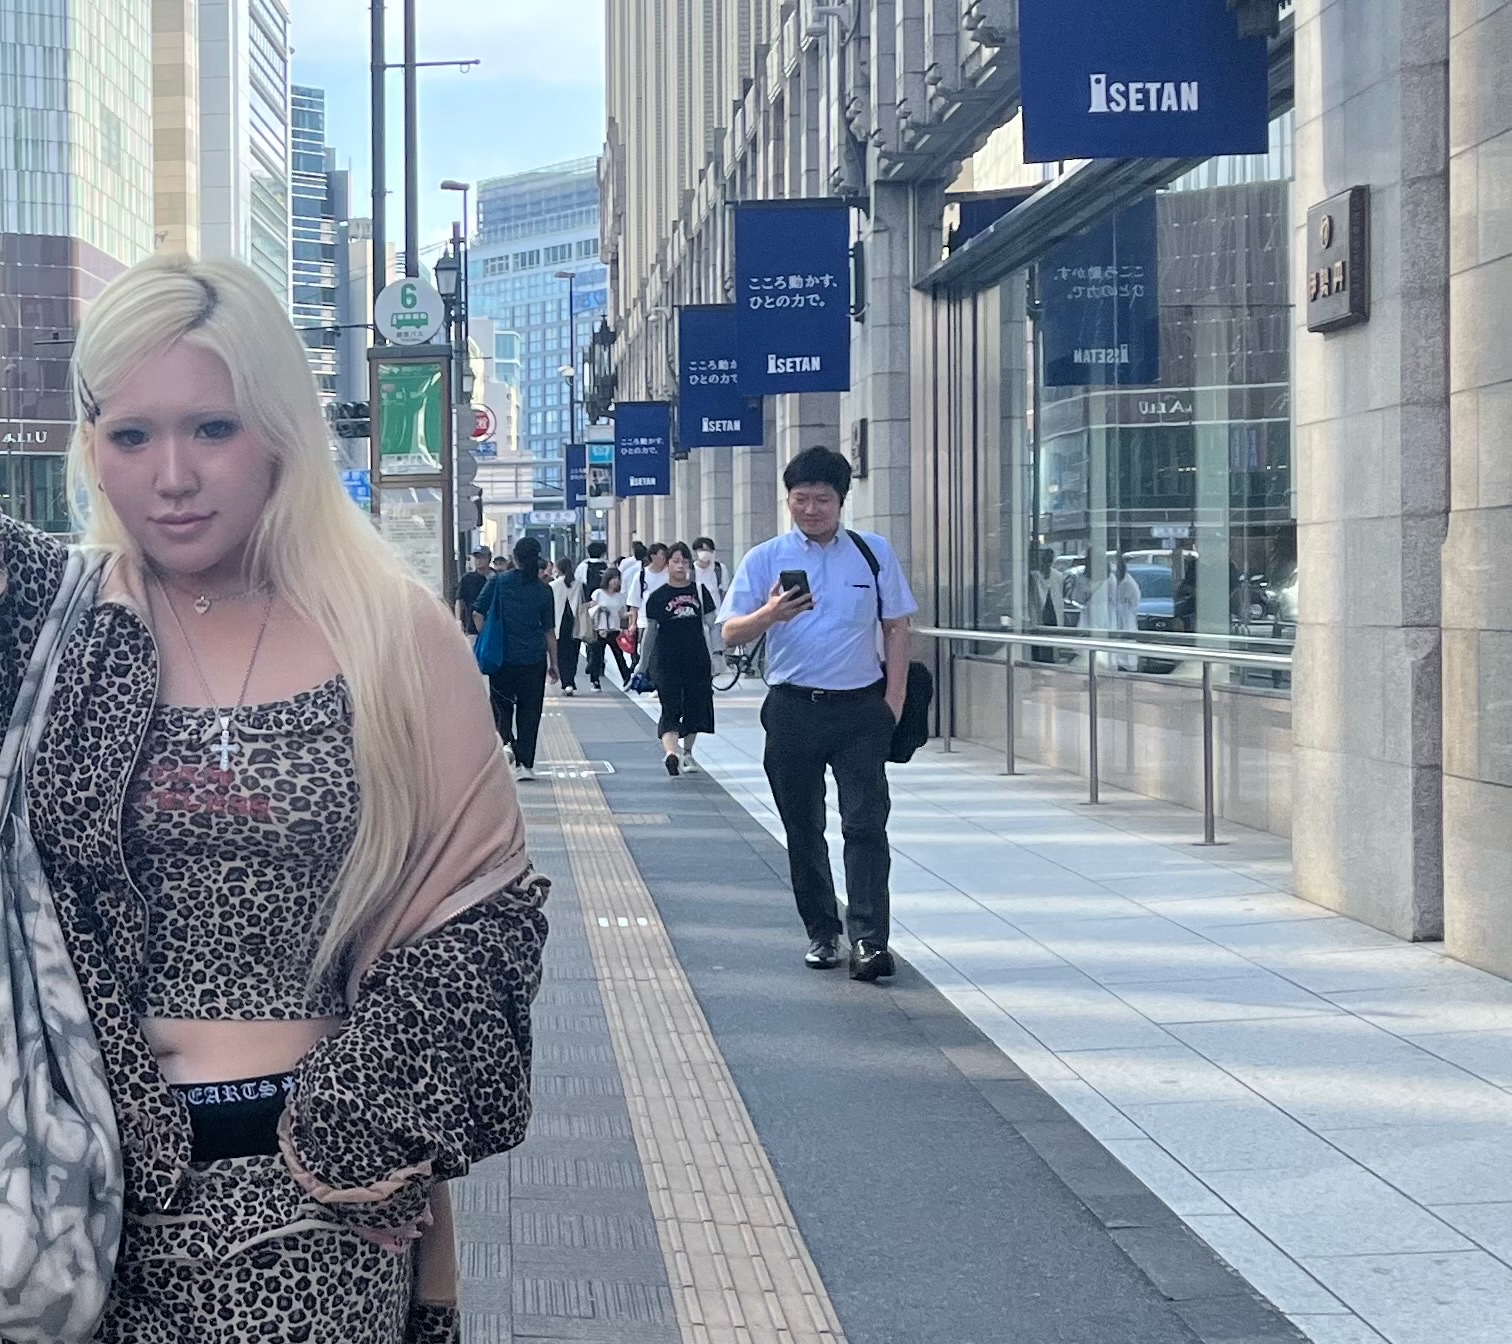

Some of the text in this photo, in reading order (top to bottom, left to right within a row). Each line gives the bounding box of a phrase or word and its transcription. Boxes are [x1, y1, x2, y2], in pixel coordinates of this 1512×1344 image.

[1088, 73, 1199, 113] ISETAN
[749, 274, 838, 290] こころ動かす、
[401, 283, 417, 309] 6
[749, 293, 826, 310] ひとの力で。
[767, 354, 821, 374] ISETAN
[702, 417, 741, 433] ISETAN
[2, 431, 48, 444] ALLU
